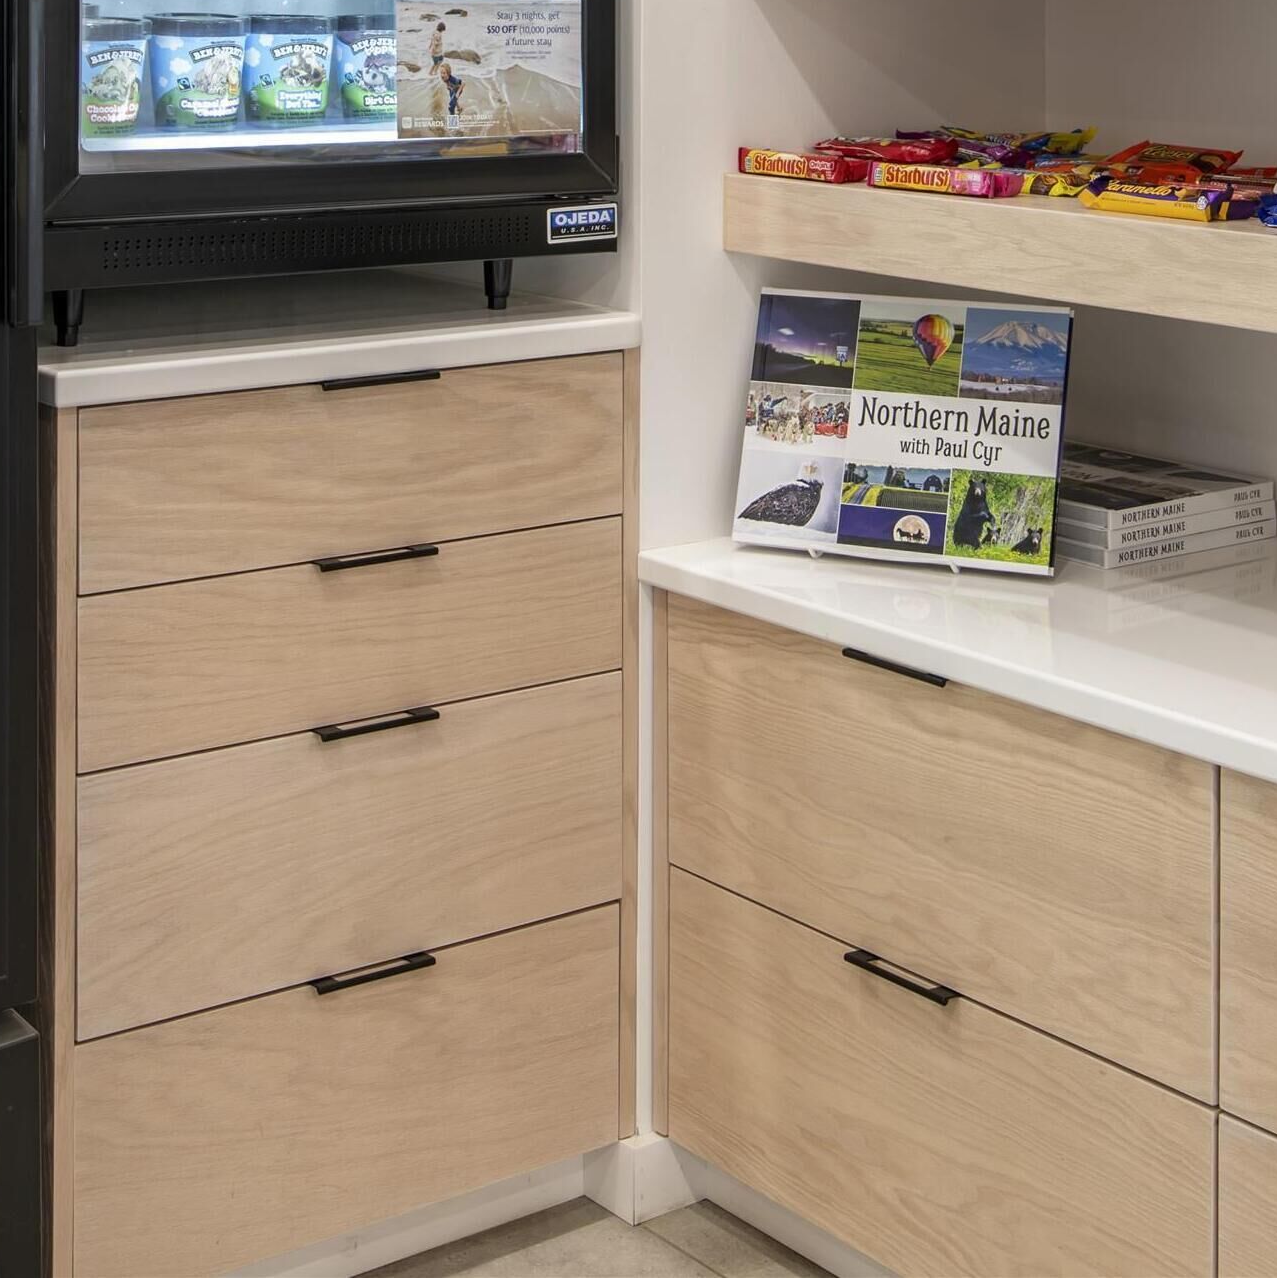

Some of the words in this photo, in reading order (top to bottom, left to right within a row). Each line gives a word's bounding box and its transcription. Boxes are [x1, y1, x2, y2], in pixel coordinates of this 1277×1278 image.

[497, 11, 513, 20] Stay
[515, 12, 520, 20] 3
[522, 11, 546, 21] nights,
[548, 11, 560, 21] get
[487, 25, 500, 34] $50
[502, 26, 517, 34] OFF
[519, 25, 545, 34] (10,000
[546, 26, 570, 34] points)
[512, 37, 534, 46] future
[536, 38, 552, 46] stay
[365, 96, 383, 105] Dirt
[754, 153, 807, 177] Starburst
[884, 165, 951, 187] Starburst
[555, 210, 611, 225] OJEDA
[858, 396, 969, 432] Northern
[974, 406, 1050, 440] Maine
[900, 438, 930, 455] with
[935, 437, 968, 458] Paul
[973, 441, 1002, 466] Cyr
[1122, 507, 1160, 524] NORTHERN
[1162, 503, 1185, 517] MAINE
[1234, 491, 1248, 502] PAUL
[1249, 489, 1261, 499] CYR
[1122, 526, 1160, 544] NORTHERN
[1162, 522, 1186, 535] MAINE
[1235, 509, 1250, 521] PAUL
[1251, 507, 1263, 517] CYR
[1118, 545, 1159, 563] NORTHERN
[1161, 541, 1185, 555] MAINE
[1236, 528, 1251, 539] PAUL
[1251, 526, 1264, 536] CYR
